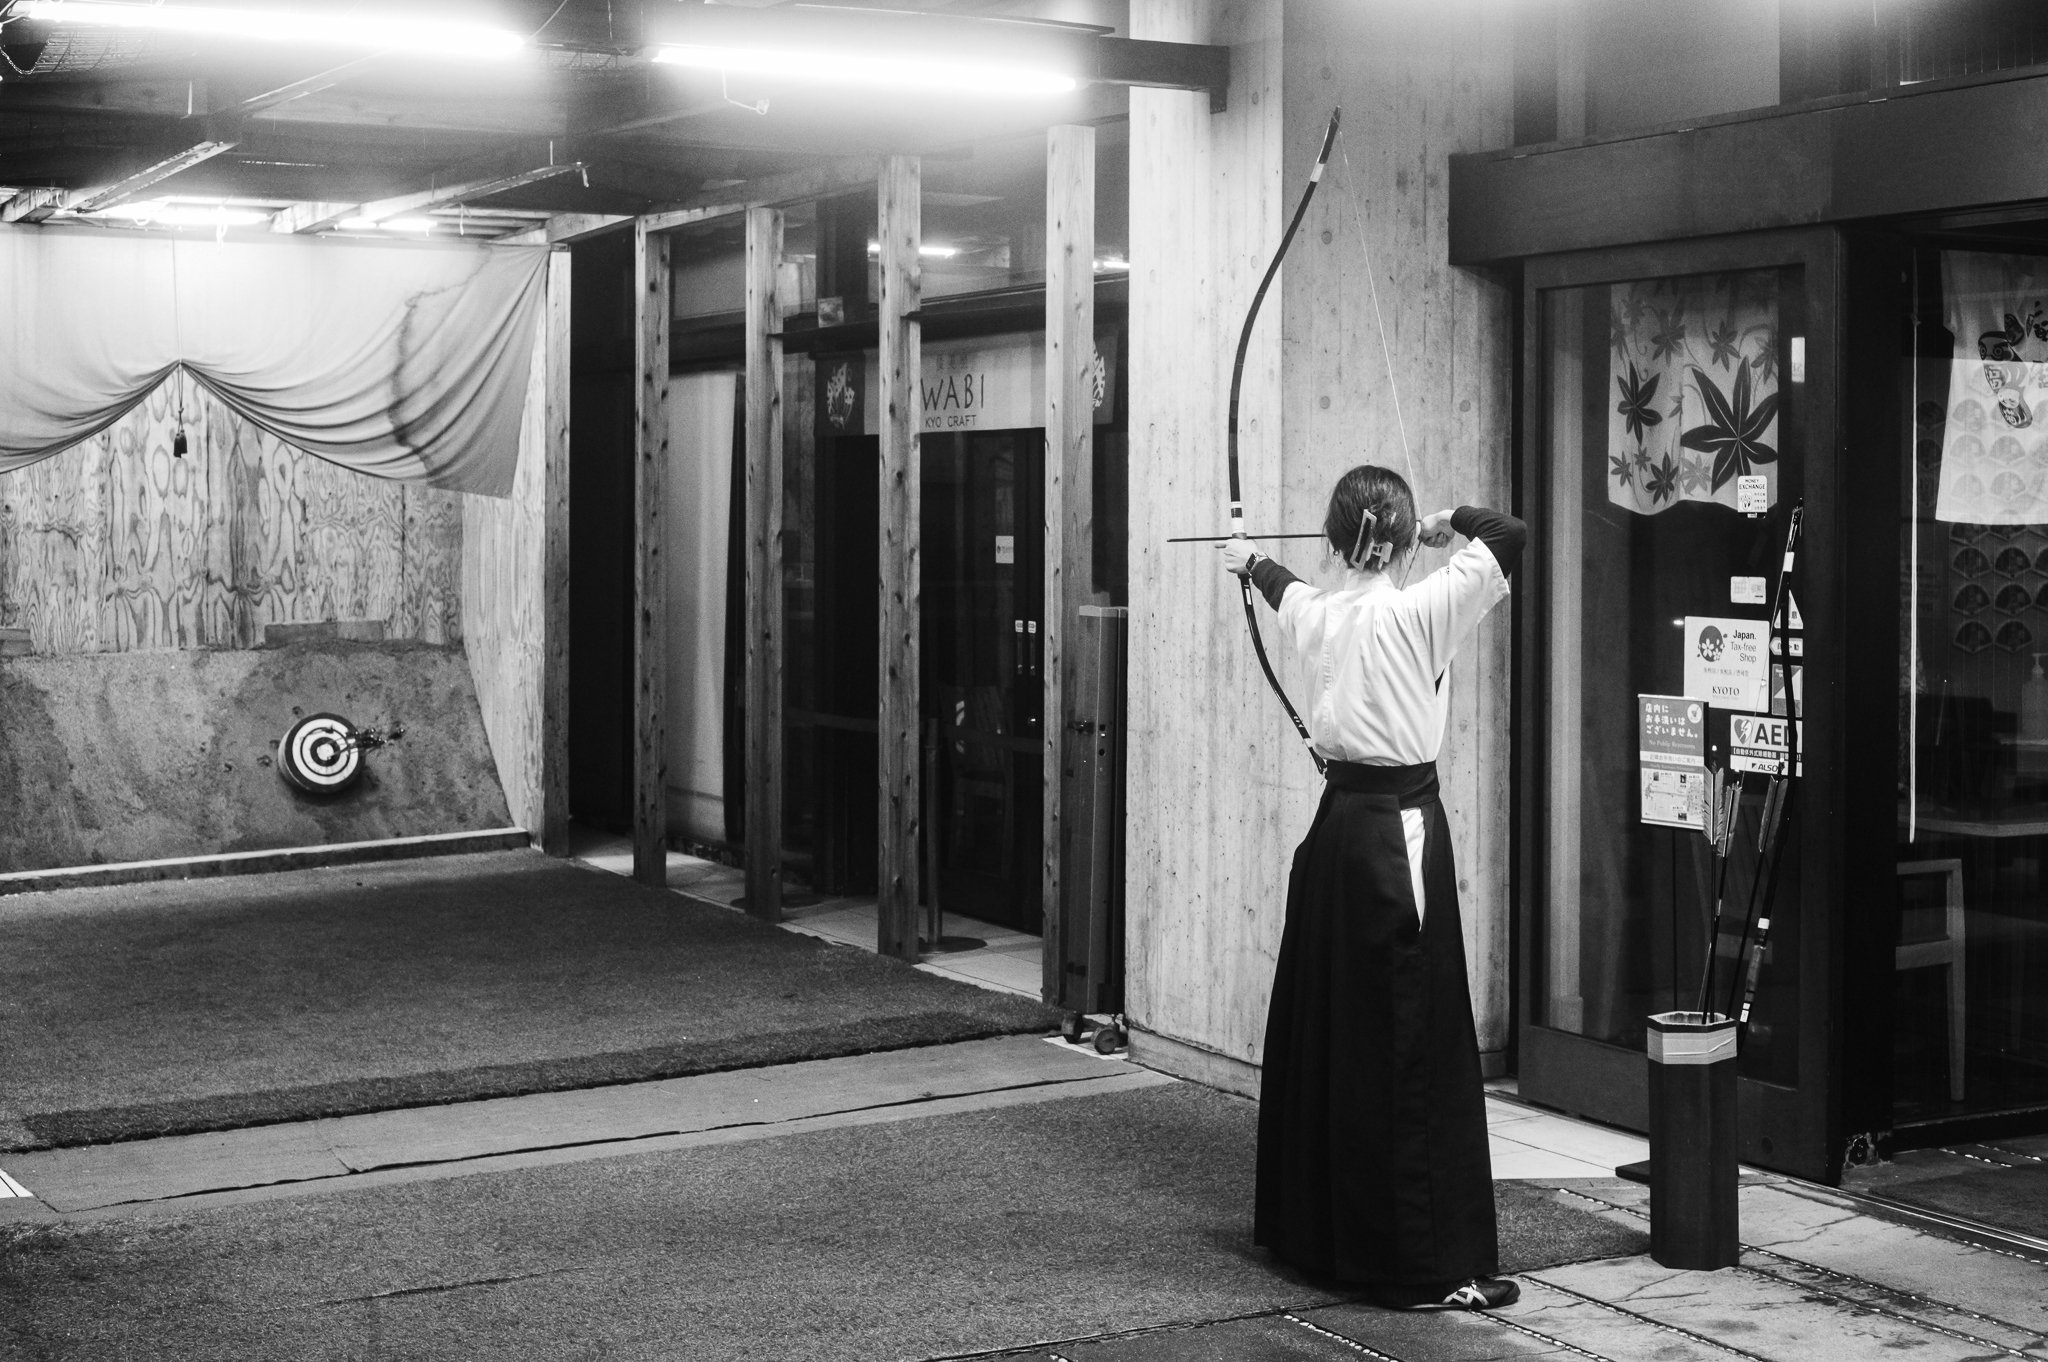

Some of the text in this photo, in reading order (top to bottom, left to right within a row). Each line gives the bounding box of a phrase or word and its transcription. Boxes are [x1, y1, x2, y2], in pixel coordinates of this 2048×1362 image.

[921, 373, 984, 411] WABI
[925, 414, 977, 428] KYO CRAFT
[1733, 629, 1757, 640] Japan.
[1730, 641, 1757, 652] Tax-free
[1739, 652, 1757, 664] Shop
[1712, 685, 1740, 696] KYOTO
[1645, 703, 1669, 714] 店内に
[1645, 714, 1686, 726] お手洗いは
[1758, 763, 1779, 773] ALSO
